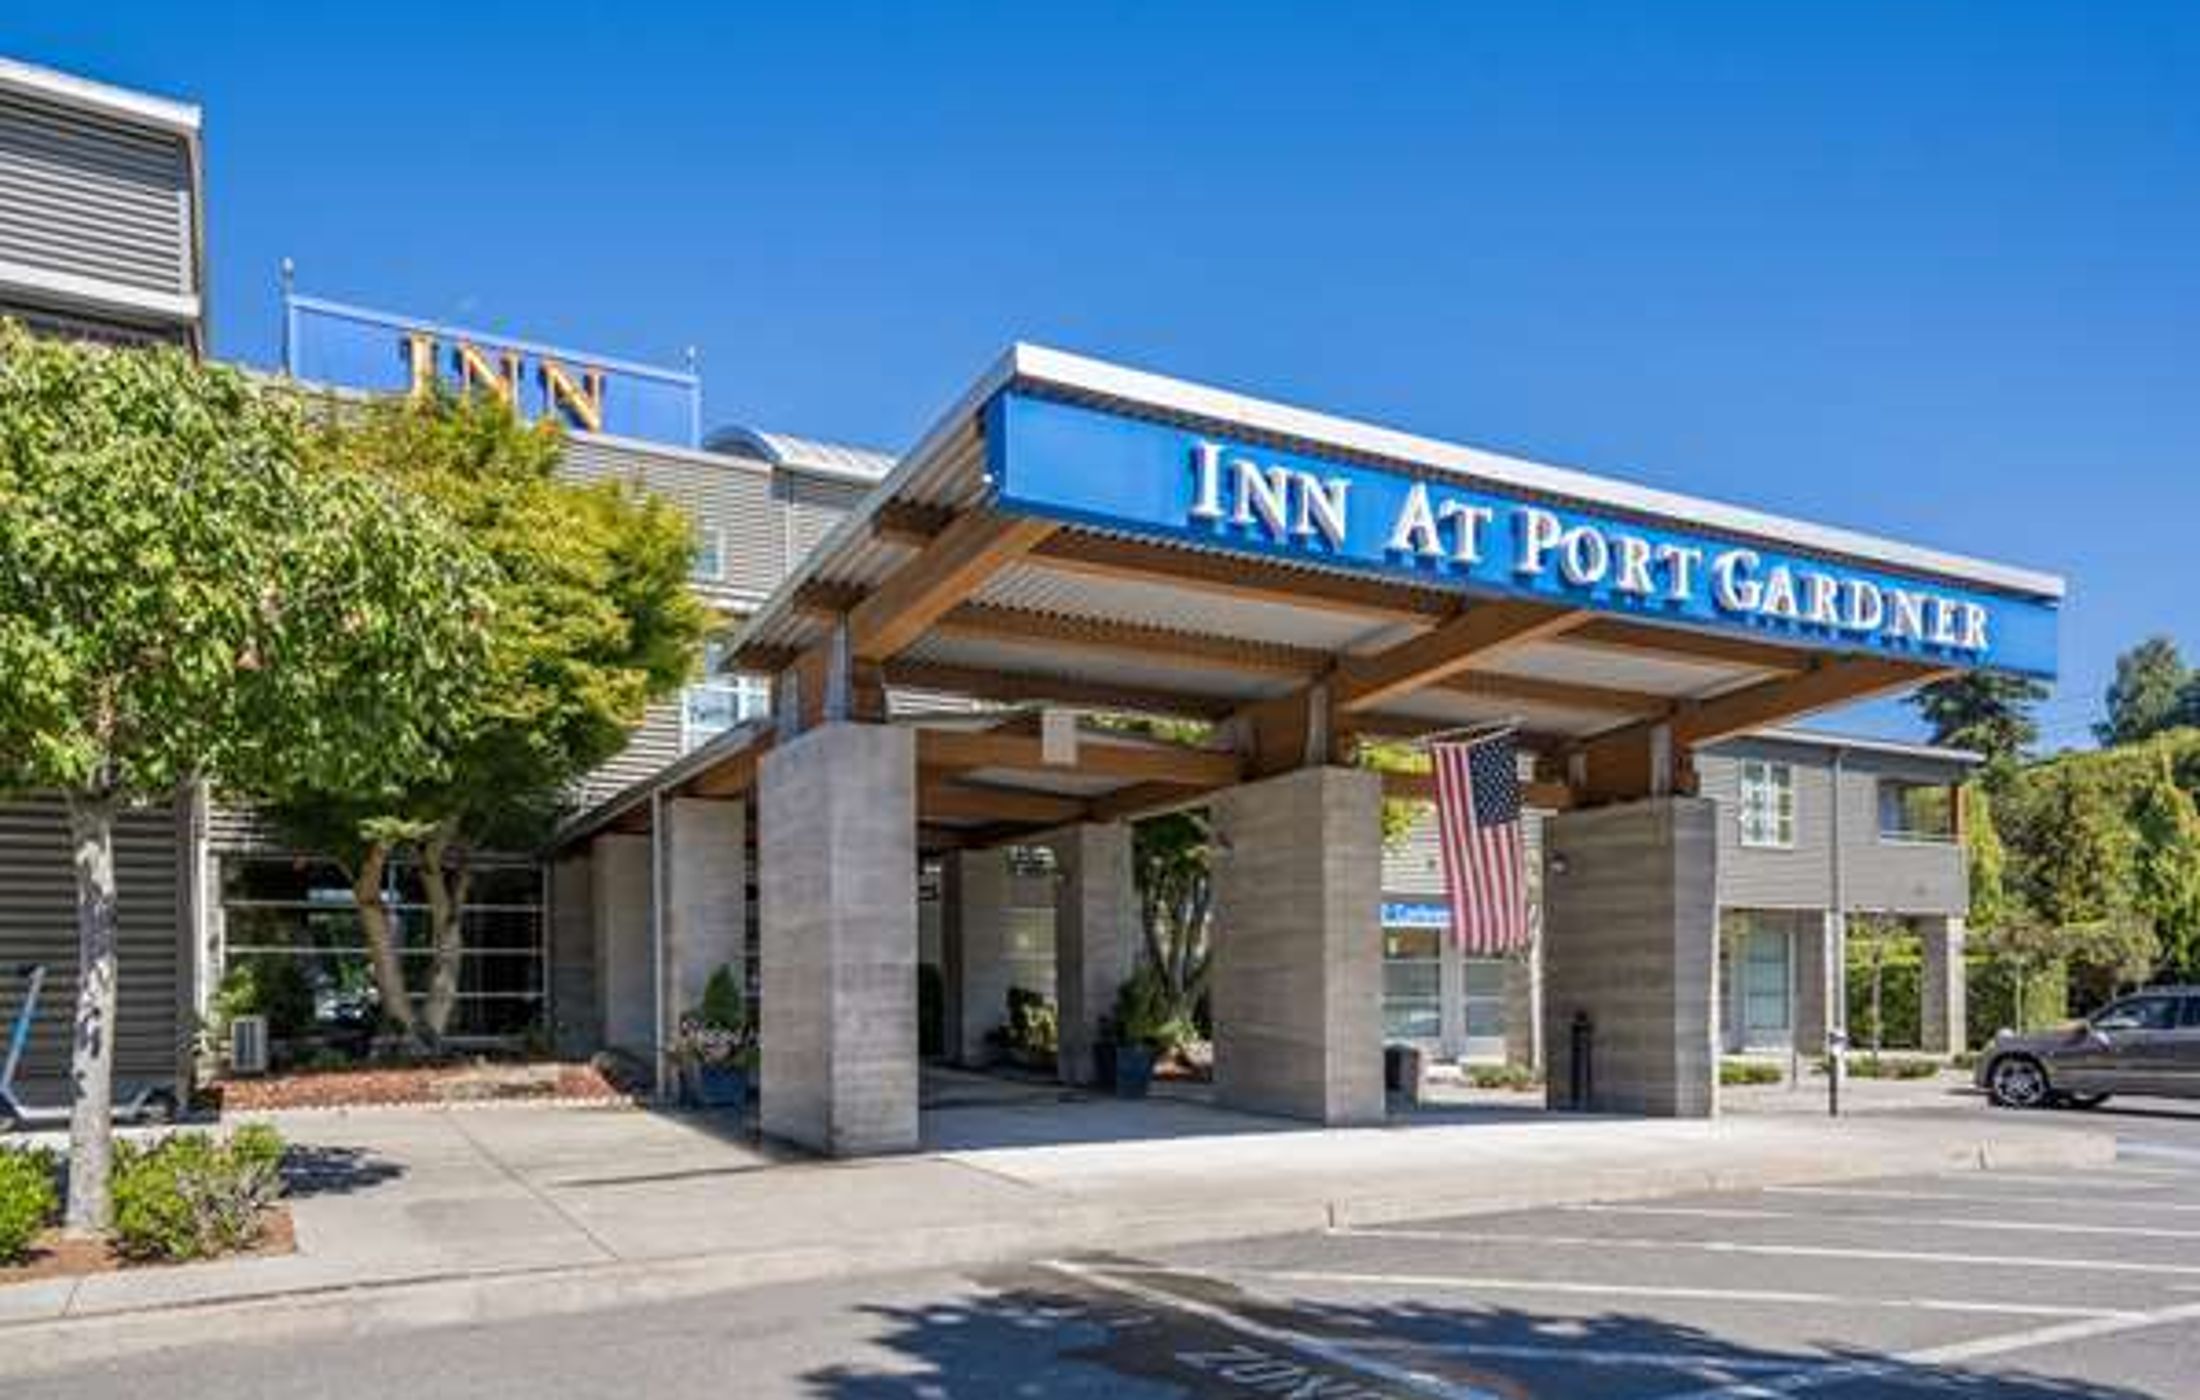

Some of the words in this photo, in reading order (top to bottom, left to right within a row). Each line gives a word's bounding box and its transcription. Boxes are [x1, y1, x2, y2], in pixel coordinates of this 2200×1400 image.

[406, 333, 604, 431] INN
[1191, 441, 1351, 554] INN
[1385, 482, 1492, 564] AT
[1514, 506, 1701, 600] PORT
[1712, 548, 1989, 650] GARDNER
